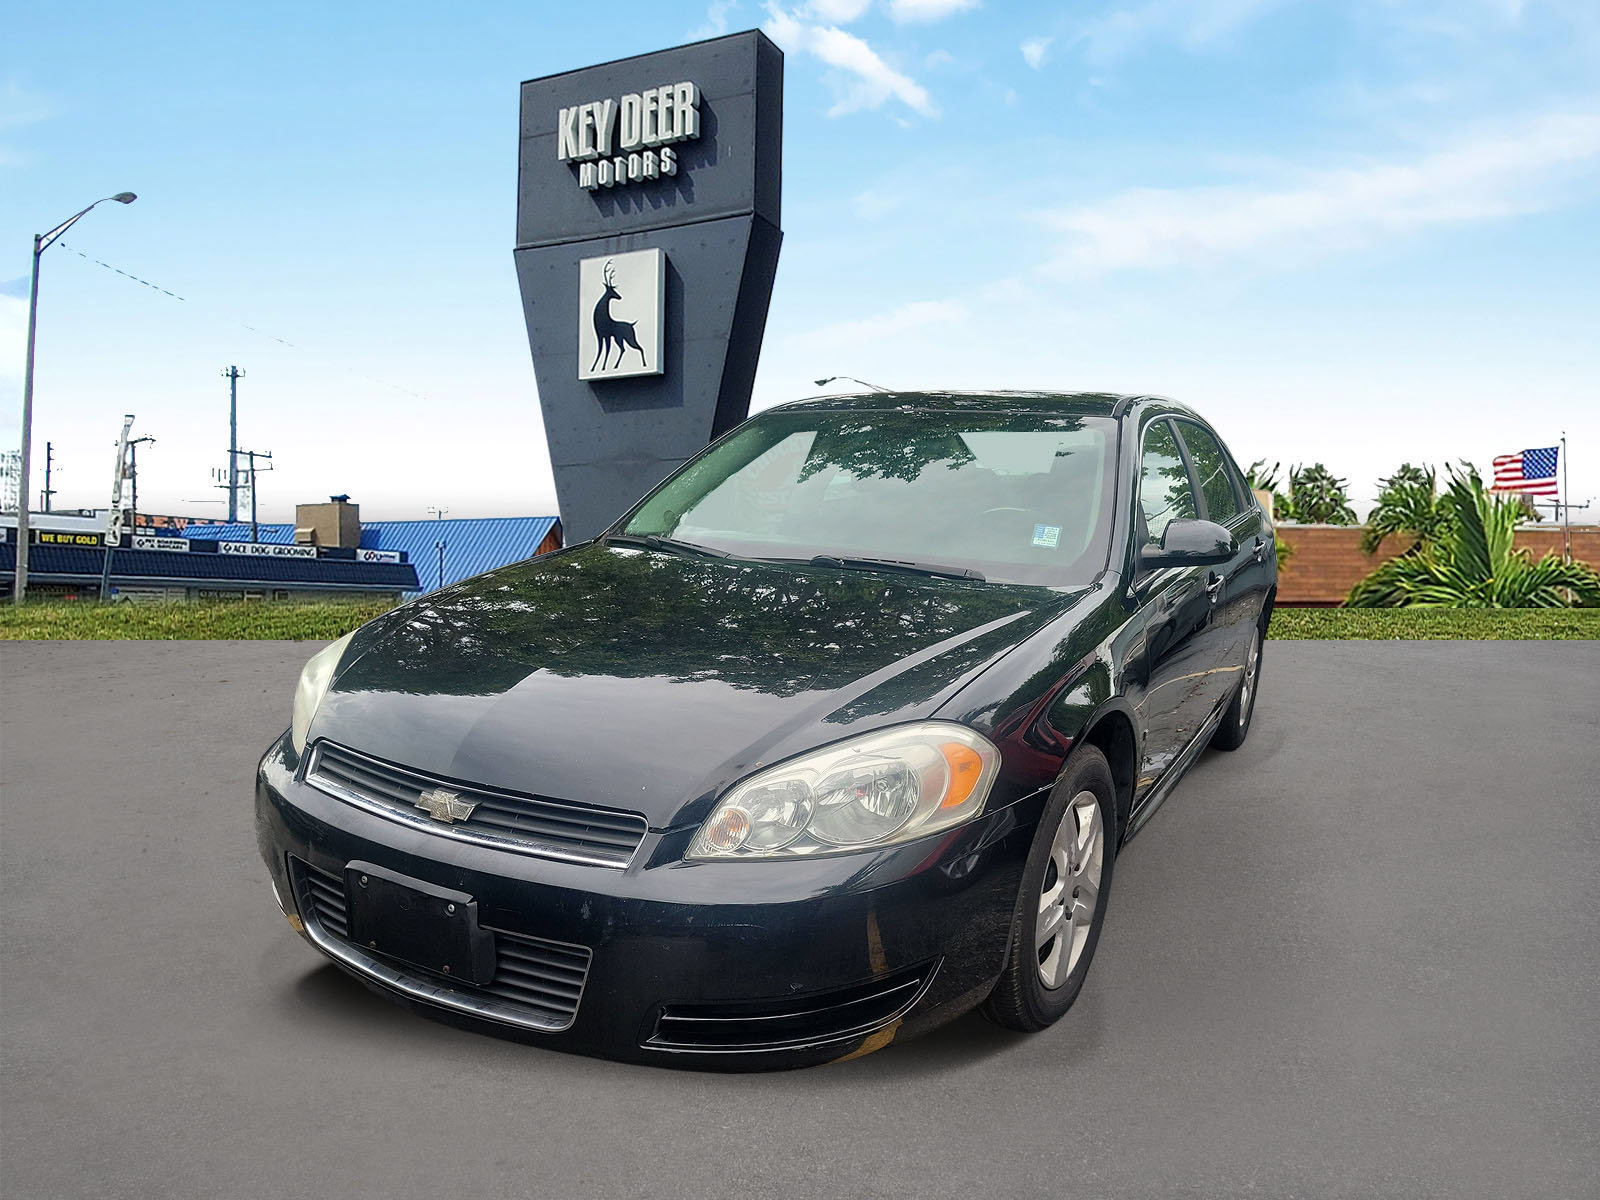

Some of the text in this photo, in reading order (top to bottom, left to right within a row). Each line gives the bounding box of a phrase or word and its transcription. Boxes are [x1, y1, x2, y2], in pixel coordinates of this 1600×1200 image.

[558, 81, 699, 162] KEY DEER
[579, 147, 676, 191] MOTORS
[41, 533, 97, 545] WE BUY GOLD
[232, 545, 315, 557] ACE DOG GROOMING
